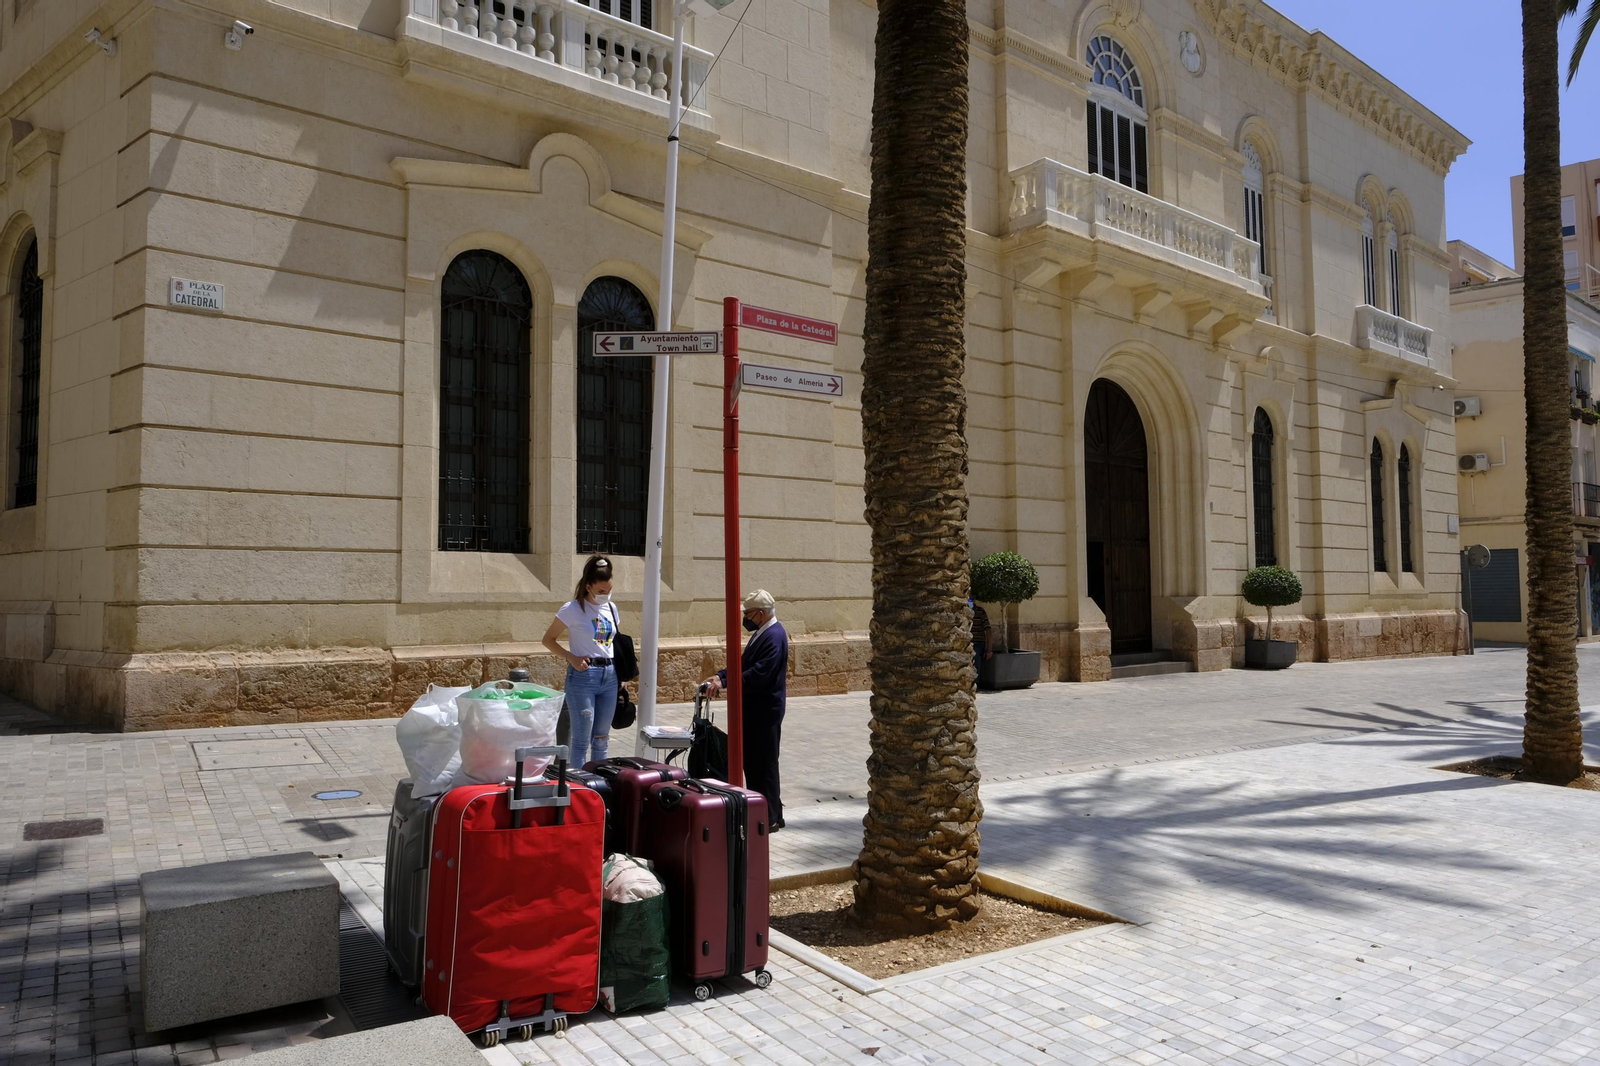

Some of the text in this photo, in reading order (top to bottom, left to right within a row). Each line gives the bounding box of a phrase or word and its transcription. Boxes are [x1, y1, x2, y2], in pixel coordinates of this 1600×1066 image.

[190, 282, 217, 292] PLAZA
[176, 294, 219, 309] CATEDRAL
[756, 314, 833, 337] Plaza de la Catedral
[640, 335, 699, 343] Ayuntamiento
[756, 372, 778, 382] Paseo
